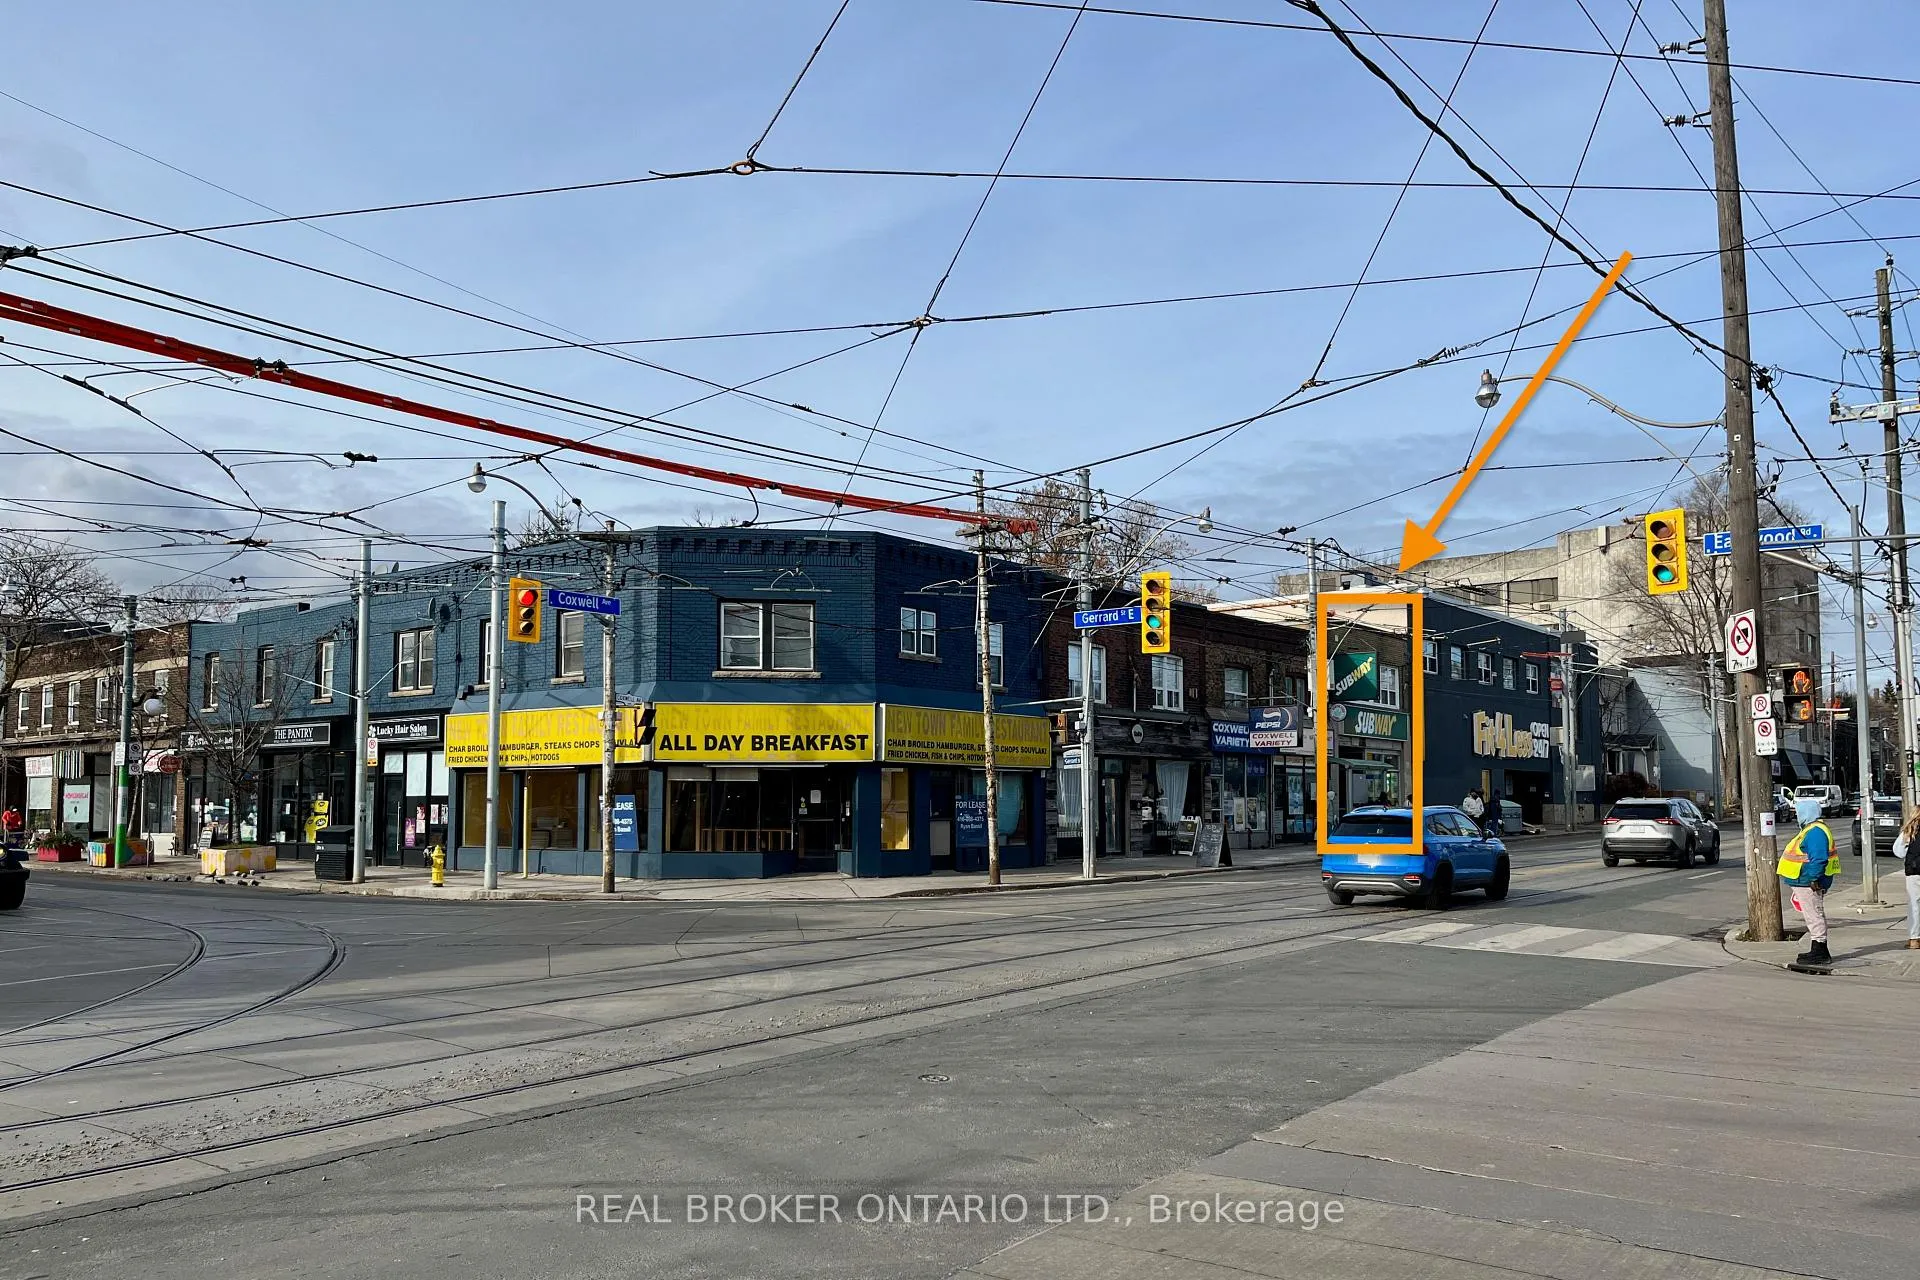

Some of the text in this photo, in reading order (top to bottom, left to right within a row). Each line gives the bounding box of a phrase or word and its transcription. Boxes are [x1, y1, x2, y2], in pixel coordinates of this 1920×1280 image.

[558, 592, 599, 610] Coxwell
[1081, 610, 1119, 624] Gerrard
[1128, 608, 1135, 620] E
[1335, 656, 1374, 697] SUBWAY
[377, 723, 427, 736] Lucky Hair Salon
[1255, 721, 1281, 729] PEPSI
[1355, 711, 1396, 736] SUBWAY
[1530, 721, 1549, 738] OPEN
[274, 727, 314, 740] THE PANTRY
[449, 745, 466, 753] CHAR
[544, 741, 571, 750] STEAKS
[573, 740, 600, 749] CHOPS
[659, 735, 869, 751] ALL DAY BREAKFAST
[887, 738, 906, 747] CHAR
[908, 739, 935, 749] BROILED
[1000, 745, 1020, 754] CHOPS
[1215, 735, 1249, 748] VARIETY
[531, 752, 560, 761] HOTDOGS
[888, 750, 904, 758] FRIED
[955, 801, 986, 809] FOR LEASE
